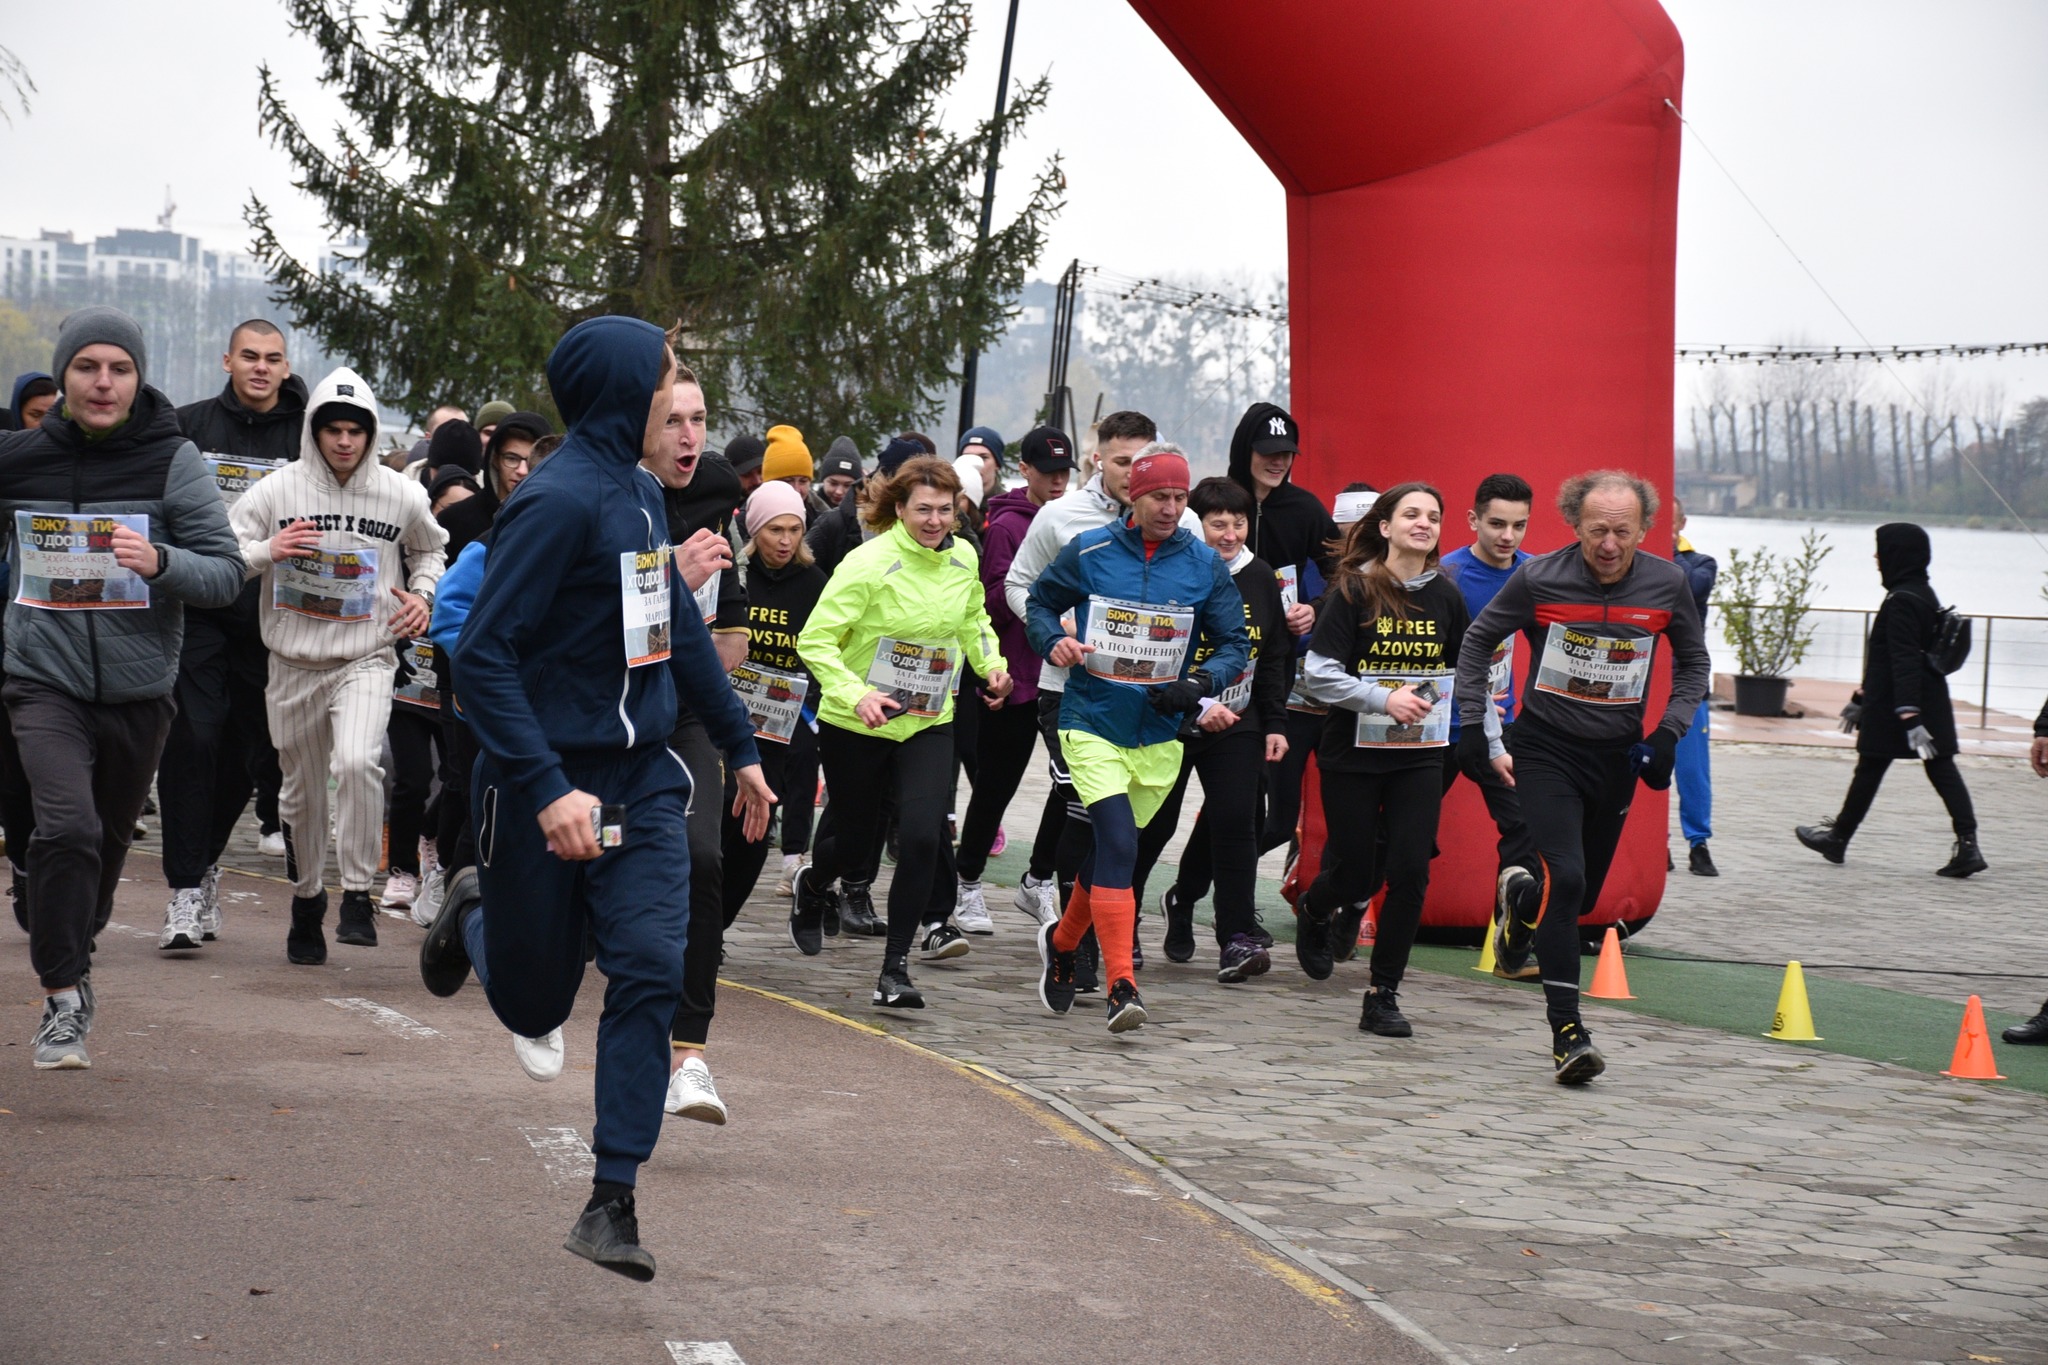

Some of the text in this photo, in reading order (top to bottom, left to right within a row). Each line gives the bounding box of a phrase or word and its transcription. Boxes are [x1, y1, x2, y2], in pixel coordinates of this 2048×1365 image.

[31, 517, 67, 532] БІЖУ
[68, 519, 89, 533] ЗА
[345, 515, 355, 532] X
[23, 532, 43, 546] ХТО
[44, 534, 75, 548] ДОСІ
[78, 535, 88, 547] В
[326, 564, 335, 574] В
[636, 552, 657, 570] БІЖУ
[627, 573, 644, 589] ХТО
[749, 606, 789, 625] FREE
[1107, 609, 1136, 623] БІЖУ
[1137, 614, 1152, 625] ЗА
[1094, 619, 1188, 639] ХТО ДОСІ В ПОЛОНІ
[1396, 620, 1436, 636] FREE
[1565, 630, 1596, 646] БІЖУ
[1596, 639, 1611, 649] ЗА
[893, 643, 922, 657] БІЖУ
[1108, 641, 1185, 657] ПОЛОНЕНИХ
[1552, 637, 1648, 661] ХТО ДОСІ В ПОЛОНІ
[880, 651, 900, 663] ХТО
[899, 656, 923, 669] ДОСІ
[924, 660, 931, 670] В
[1569, 658, 1629, 672] ЗА ГАРНІЗОН
[1568, 667, 1626, 681] МАРІУПОЛЯ
[762, 684, 768, 694] В
